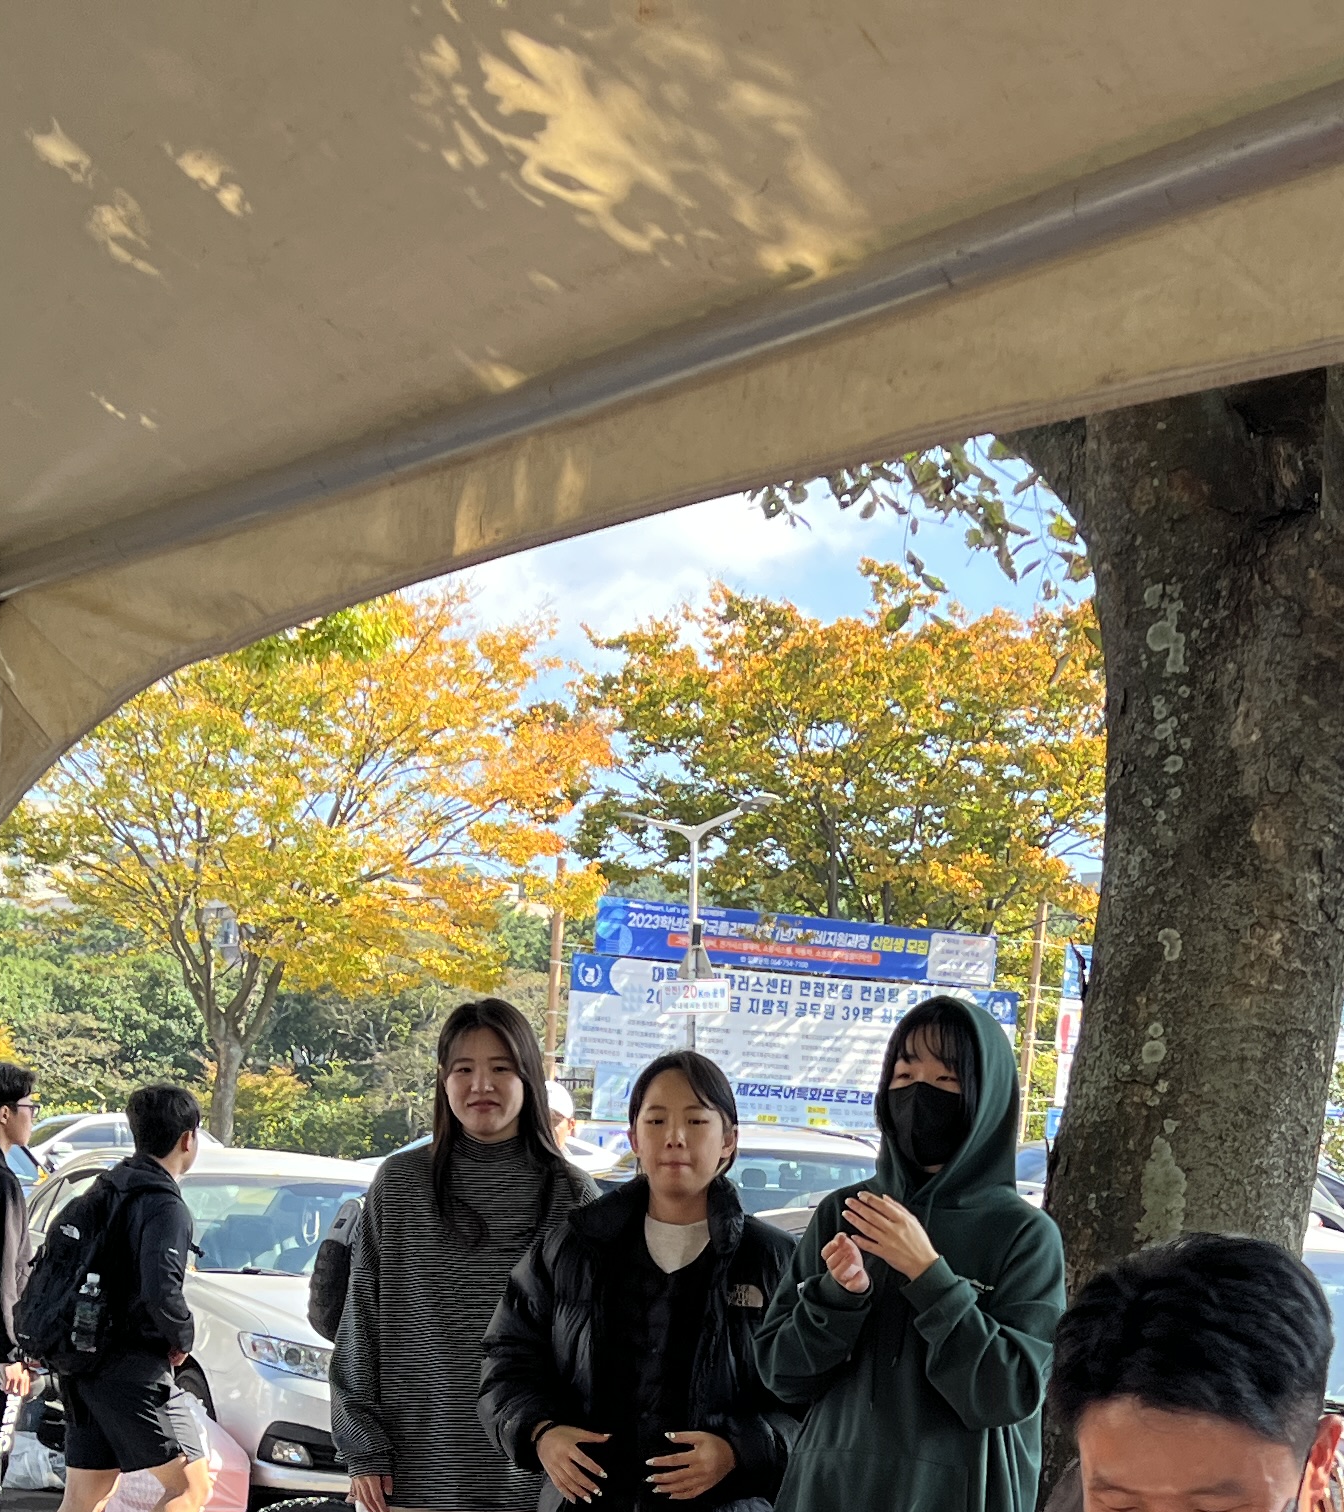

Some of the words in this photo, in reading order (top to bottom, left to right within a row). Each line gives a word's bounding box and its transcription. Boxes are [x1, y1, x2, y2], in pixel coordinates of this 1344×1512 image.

[871, 936, 905, 952] 신입생
[907, 939, 929, 956] 모집
[748, 998, 789, 1017] 지방직
[795, 1001, 836, 1021] 공무원
[841, 1006, 874, 1023] 39명
[735, 1082, 874, 1106] 제2외국어특화프로그램
